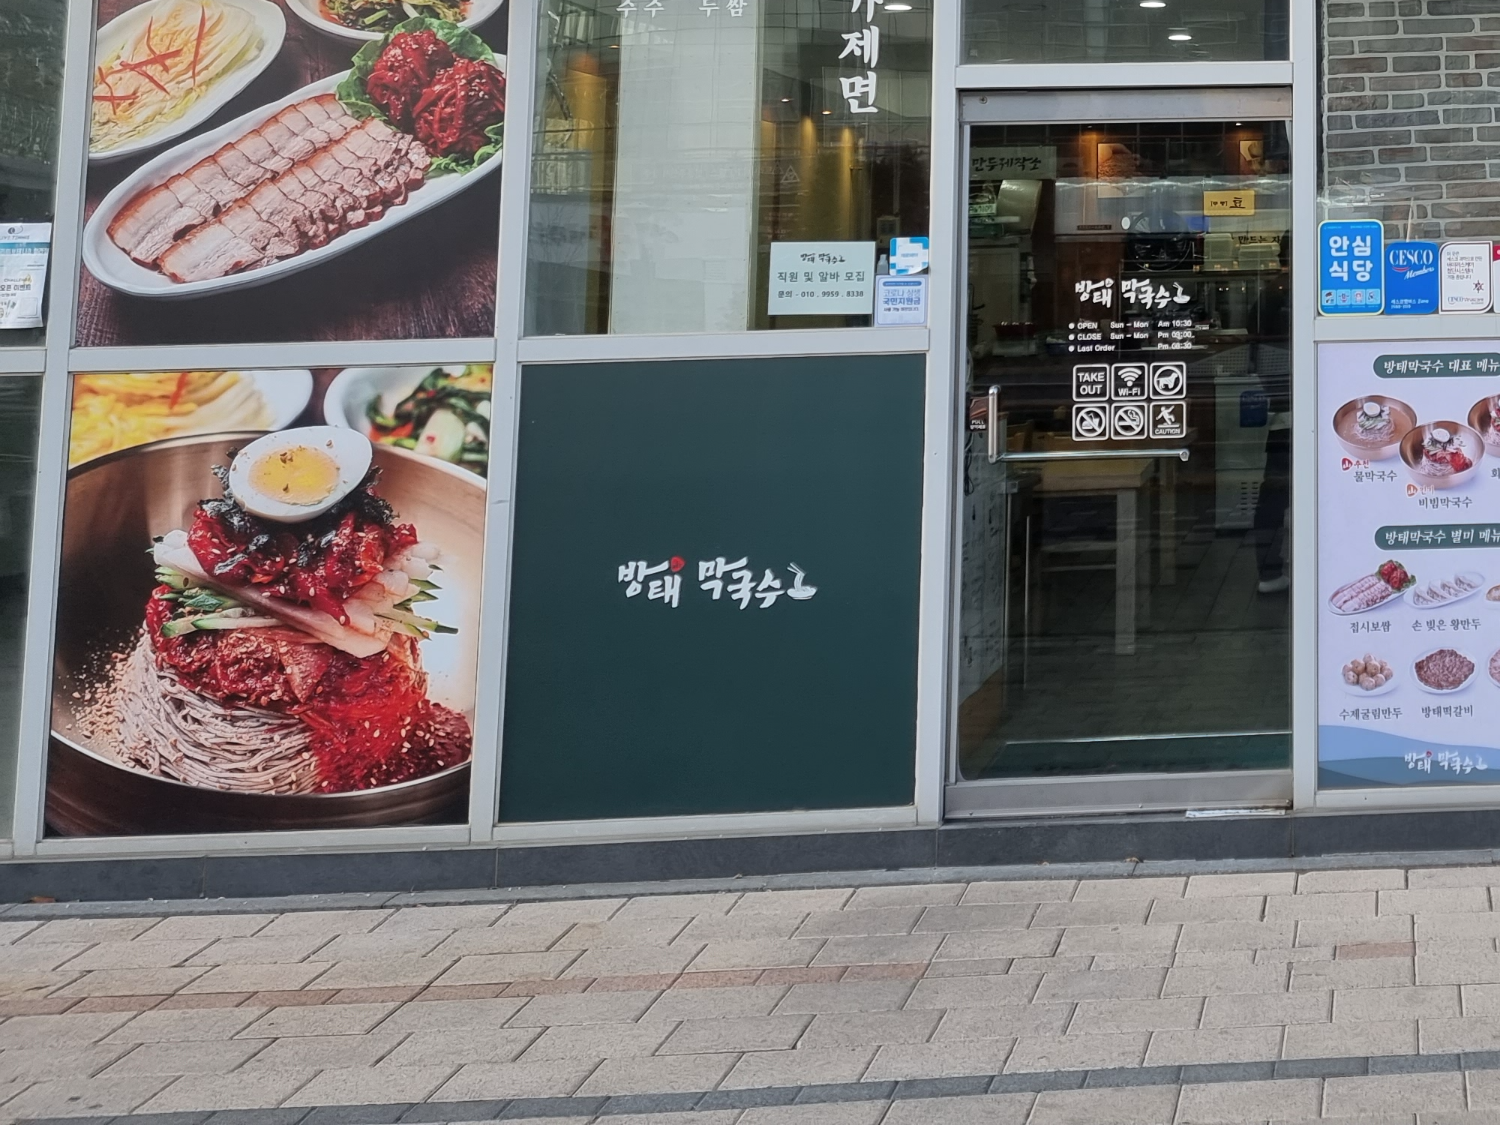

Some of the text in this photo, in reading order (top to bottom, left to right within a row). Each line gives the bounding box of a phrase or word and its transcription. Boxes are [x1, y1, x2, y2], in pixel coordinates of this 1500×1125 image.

[972, 157, 1041, 171] 만두제작소
[1329, 235, 1371, 256] 안심
[1389, 249, 1433, 265] CESCO
[777, 271, 865, 283] 직원 및 알바 모집
[1329, 260, 1373, 282] 식당
[778, 290, 793, 298] 문의
[1075, 278, 1171, 309] 방태 막국수
[883, 297, 920, 305] 국민지원금
[1110, 321, 1124, 329] Sun
[1077, 333, 1102, 341] CLOSE
[1157, 331, 1169, 339] Pm
[1383, 358, 1500, 374] 방태막국수 대표 메뉴
[1077, 372, 1105, 382] TAKE
[1080, 385, 1103, 395] OUT
[1118, 388, 1141, 396] Wi-Fi
[1354, 470, 1397, 483] 물막국수
[1418, 496, 1473, 509] 비빔막국수
[1385, 529, 1446, 544] 방태막국수
[1451, 528, 1474, 543] 별미
[618, 557, 785, 610] 방태 막국수
[1350, 620, 1391, 633] 접시보쌈
[1411, 618, 1481, 632] 손 빚은 왕만두
[1339, 707, 1403, 720] 수제굴림만두
[1421, 704, 1473, 718] 방태떡갈비
[1404, 751, 1475, 775] 방태 막국수
